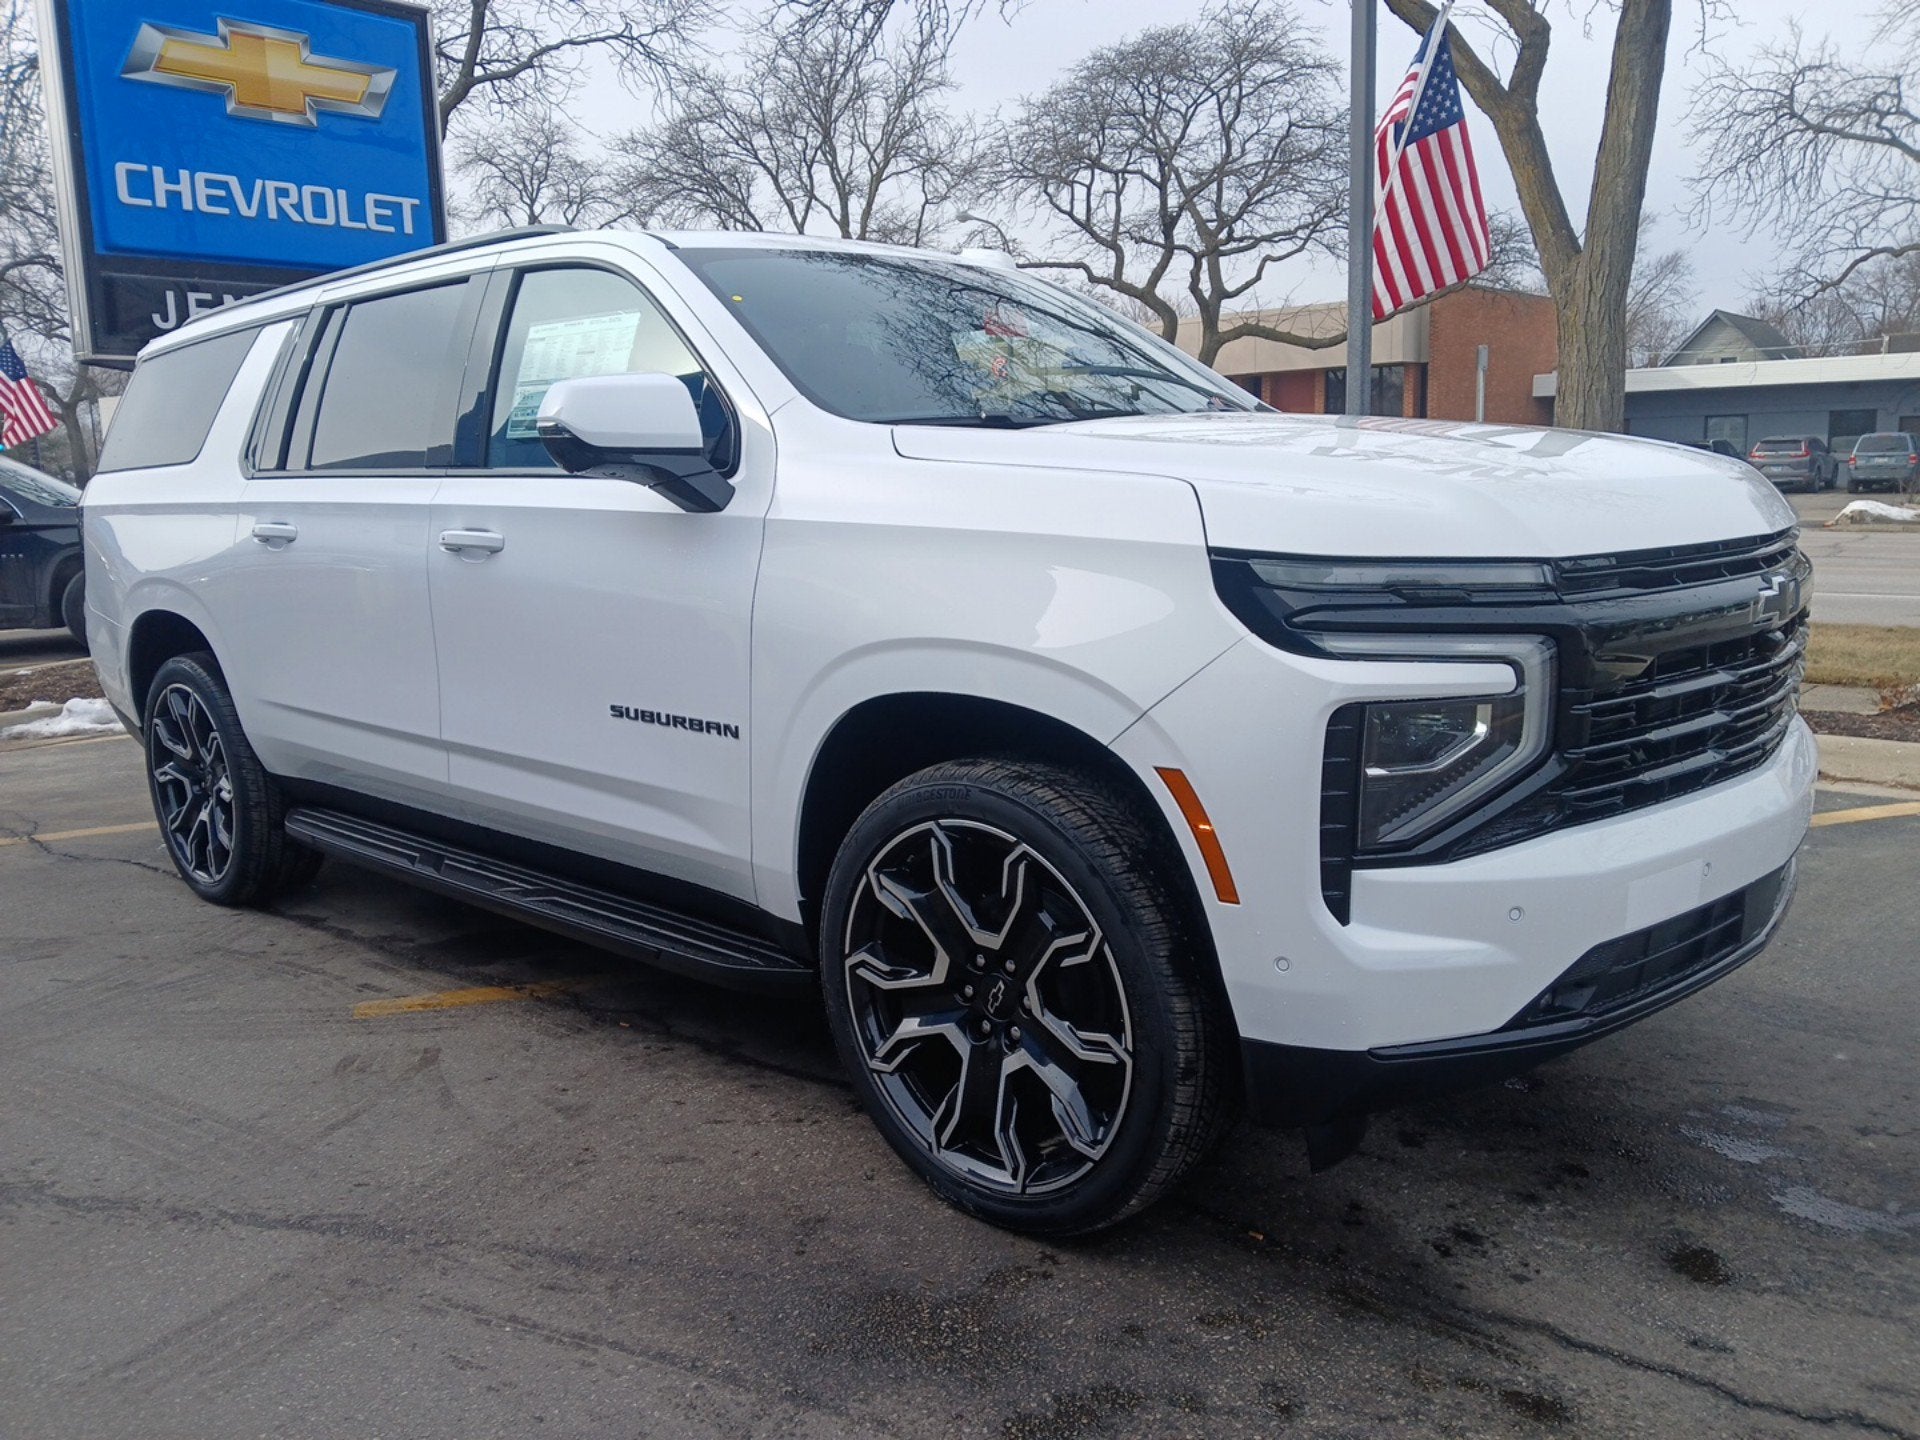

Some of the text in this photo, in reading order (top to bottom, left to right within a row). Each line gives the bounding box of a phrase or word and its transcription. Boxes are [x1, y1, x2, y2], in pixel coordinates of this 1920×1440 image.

[115, 161, 420, 234] CHEVROLET
[152, 290, 249, 329] JE
[609, 704, 740, 740] SUBURBAN
